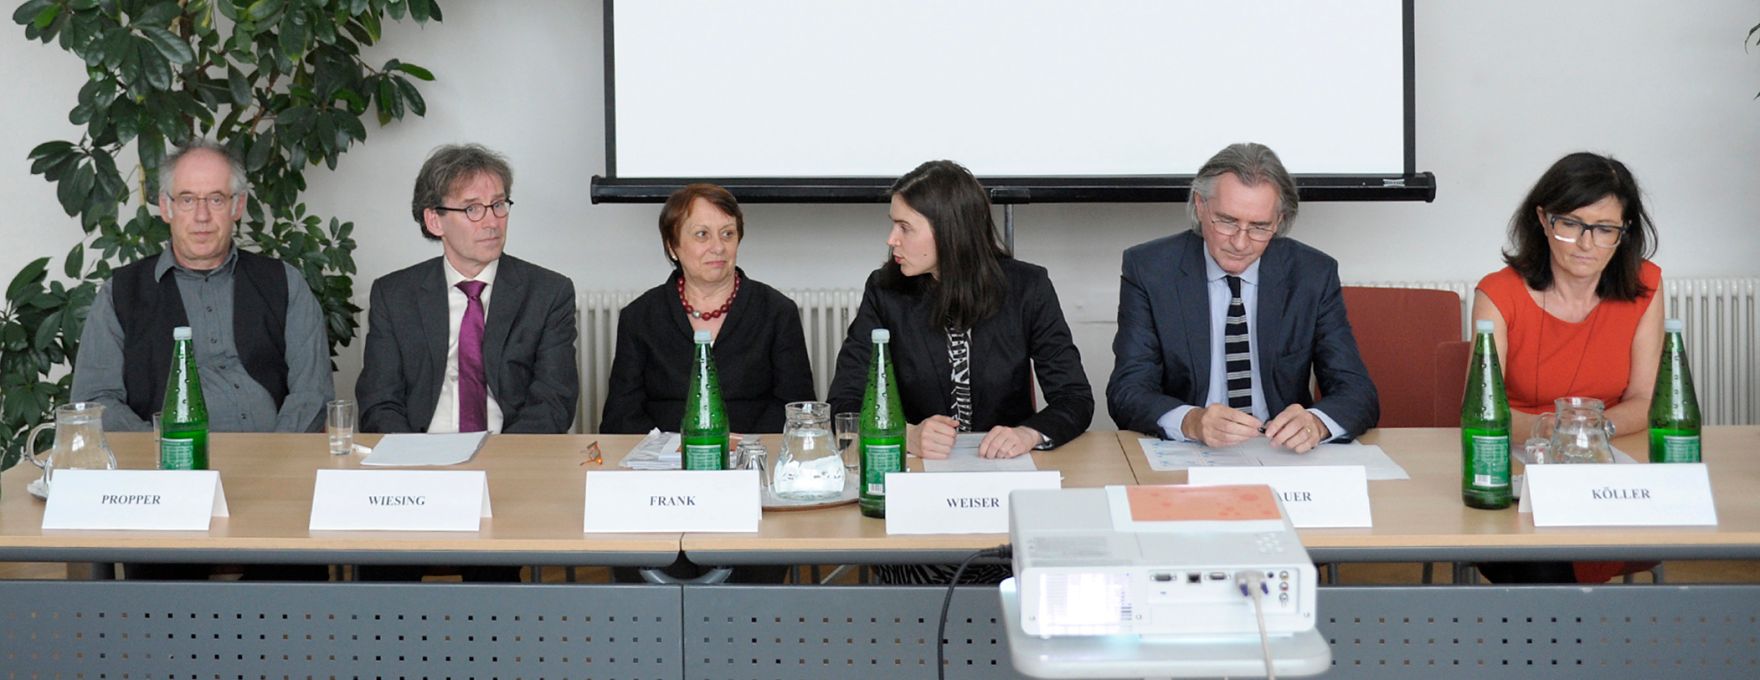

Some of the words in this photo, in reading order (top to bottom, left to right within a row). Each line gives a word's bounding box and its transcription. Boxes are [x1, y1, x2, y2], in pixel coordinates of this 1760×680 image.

[1592, 487, 1651, 500] KÖLLER
[101, 495, 161, 505] PROPPER
[368, 496, 425, 506] WIESING
[649, 496, 696, 506] FRANK
[946, 498, 1000, 508] WEISER
